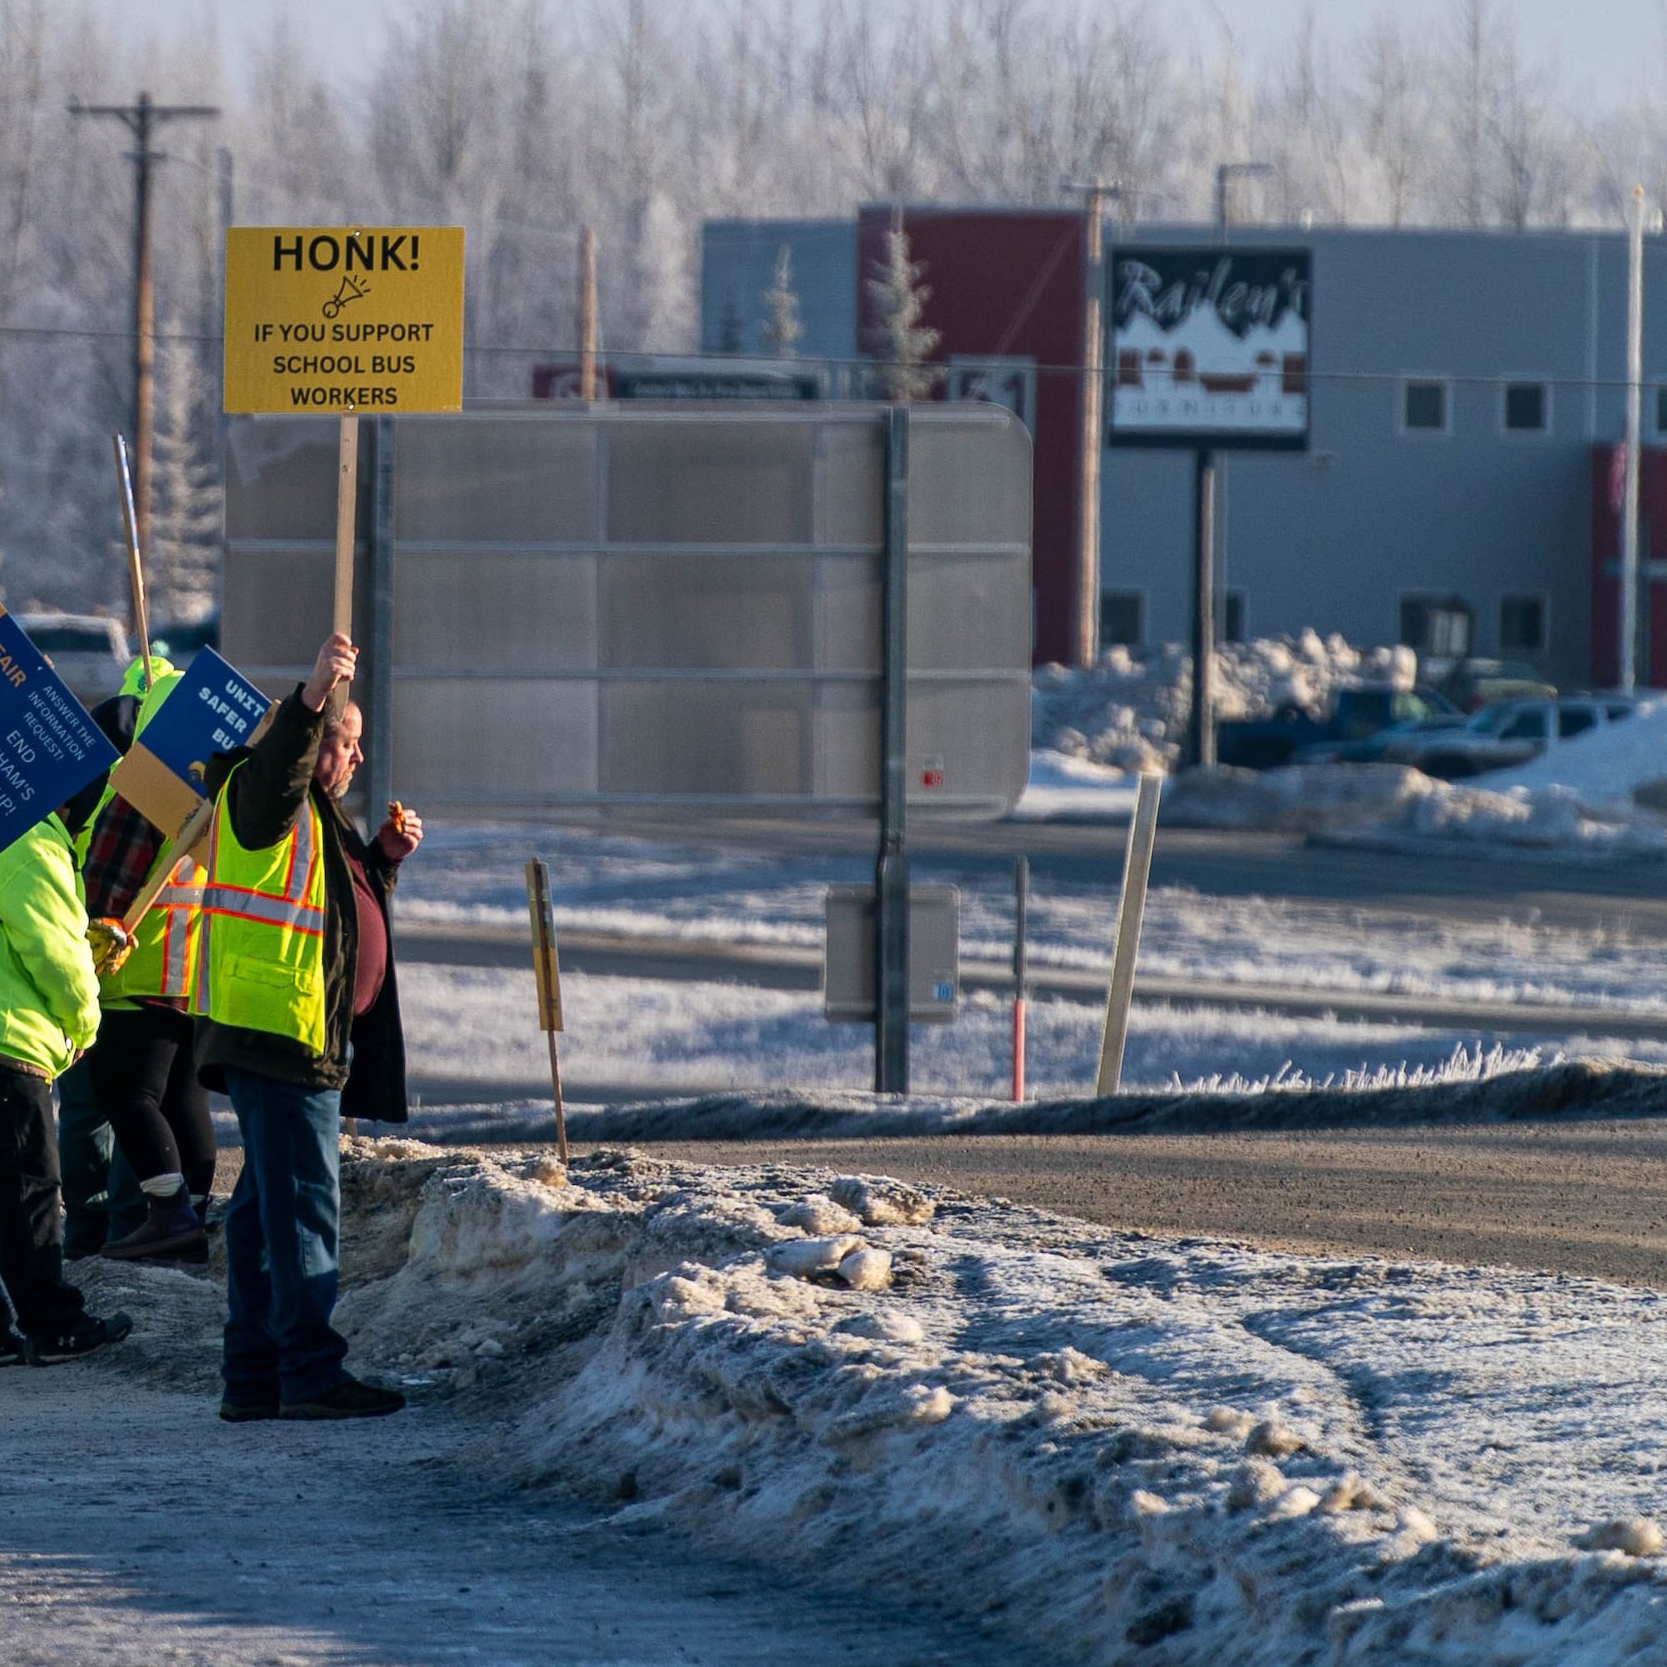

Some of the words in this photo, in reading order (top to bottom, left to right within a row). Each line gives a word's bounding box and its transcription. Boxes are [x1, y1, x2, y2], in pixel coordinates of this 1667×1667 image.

[273, 235, 420, 272] HONK!
[254, 324, 274, 342] IF
[279, 324, 326, 342] YOU
[332, 324, 434, 342] SUPPORT
[273, 355, 365, 374] SCHOOL
[372, 355, 416, 374] BUS
[290, 387, 398, 405] WORKERS
[42, 685, 80, 729] ANSWER
[75, 725, 97, 749] THE
[198, 686, 248, 734] SAFER
[225, 679, 266, 718] UNIT
[23, 712, 65, 762] REQUEST!
[28, 690, 86, 762] INFORMATION
[6, 729, 37, 764] END
